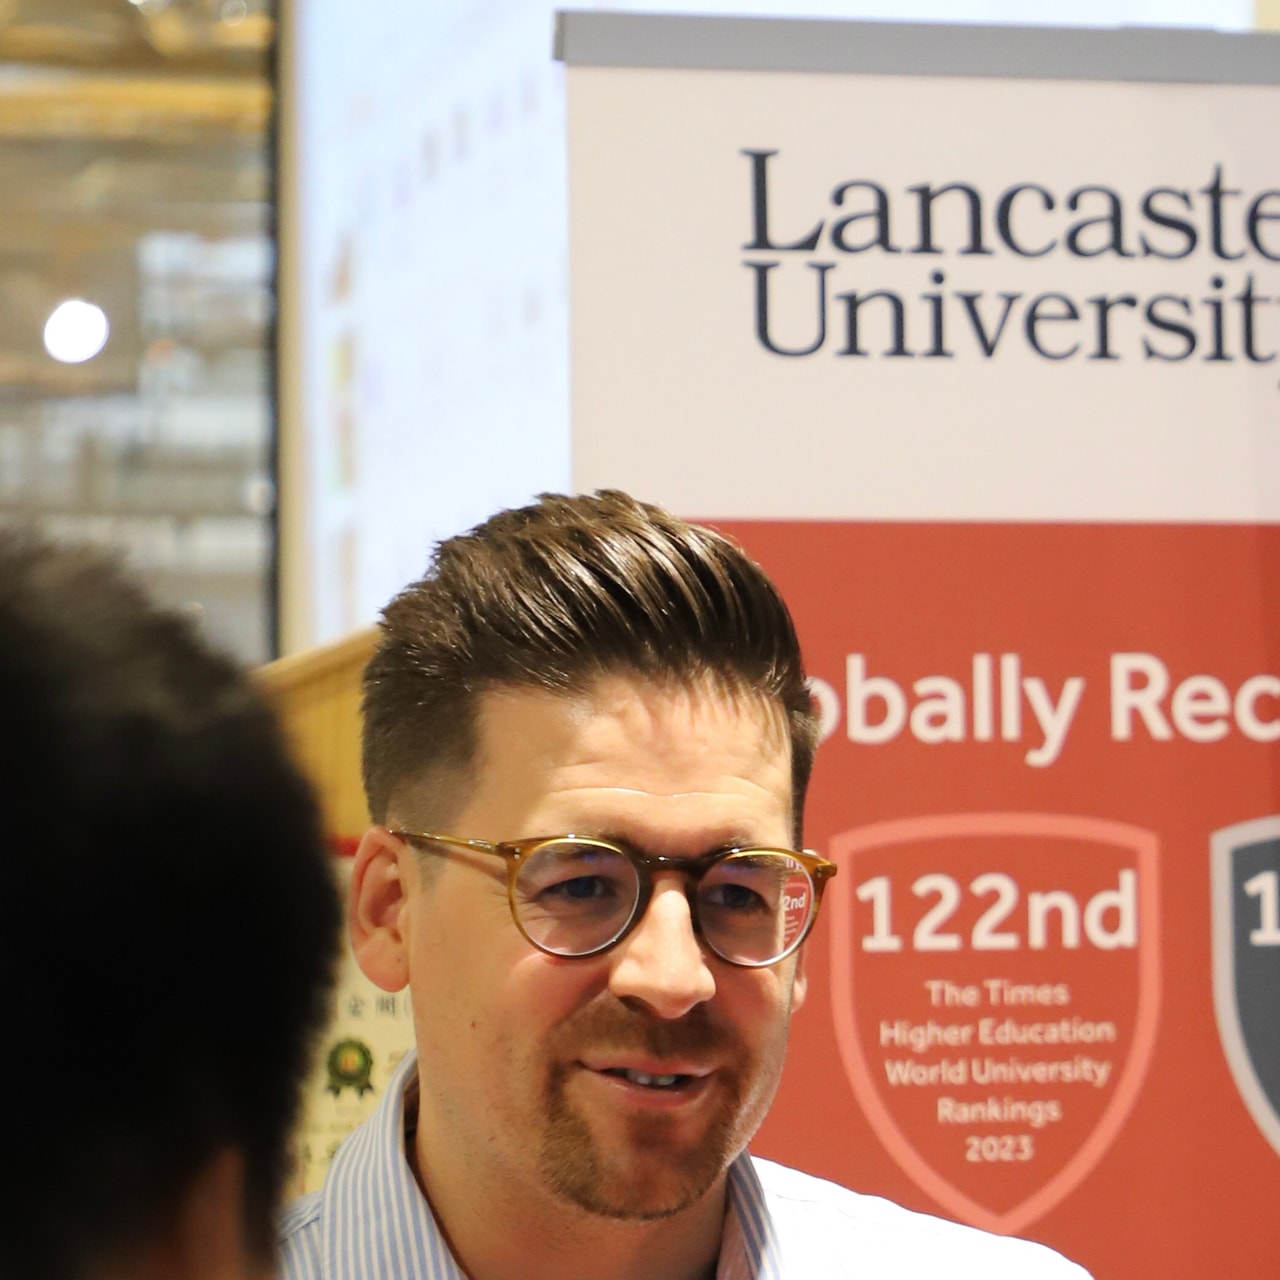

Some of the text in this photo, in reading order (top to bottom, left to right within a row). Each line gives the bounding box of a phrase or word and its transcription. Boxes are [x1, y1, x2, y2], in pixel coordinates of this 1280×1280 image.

[856, 869, 1138, 952] 122nd
[925, 978, 1070, 1007] The Times
[879, 1016, 1117, 1054] Higher Education
[885, 1055, 1113, 1088] World University
[936, 1096, 1064, 1129] Rankings
[964, 1135, 1035, 1163] 2023
